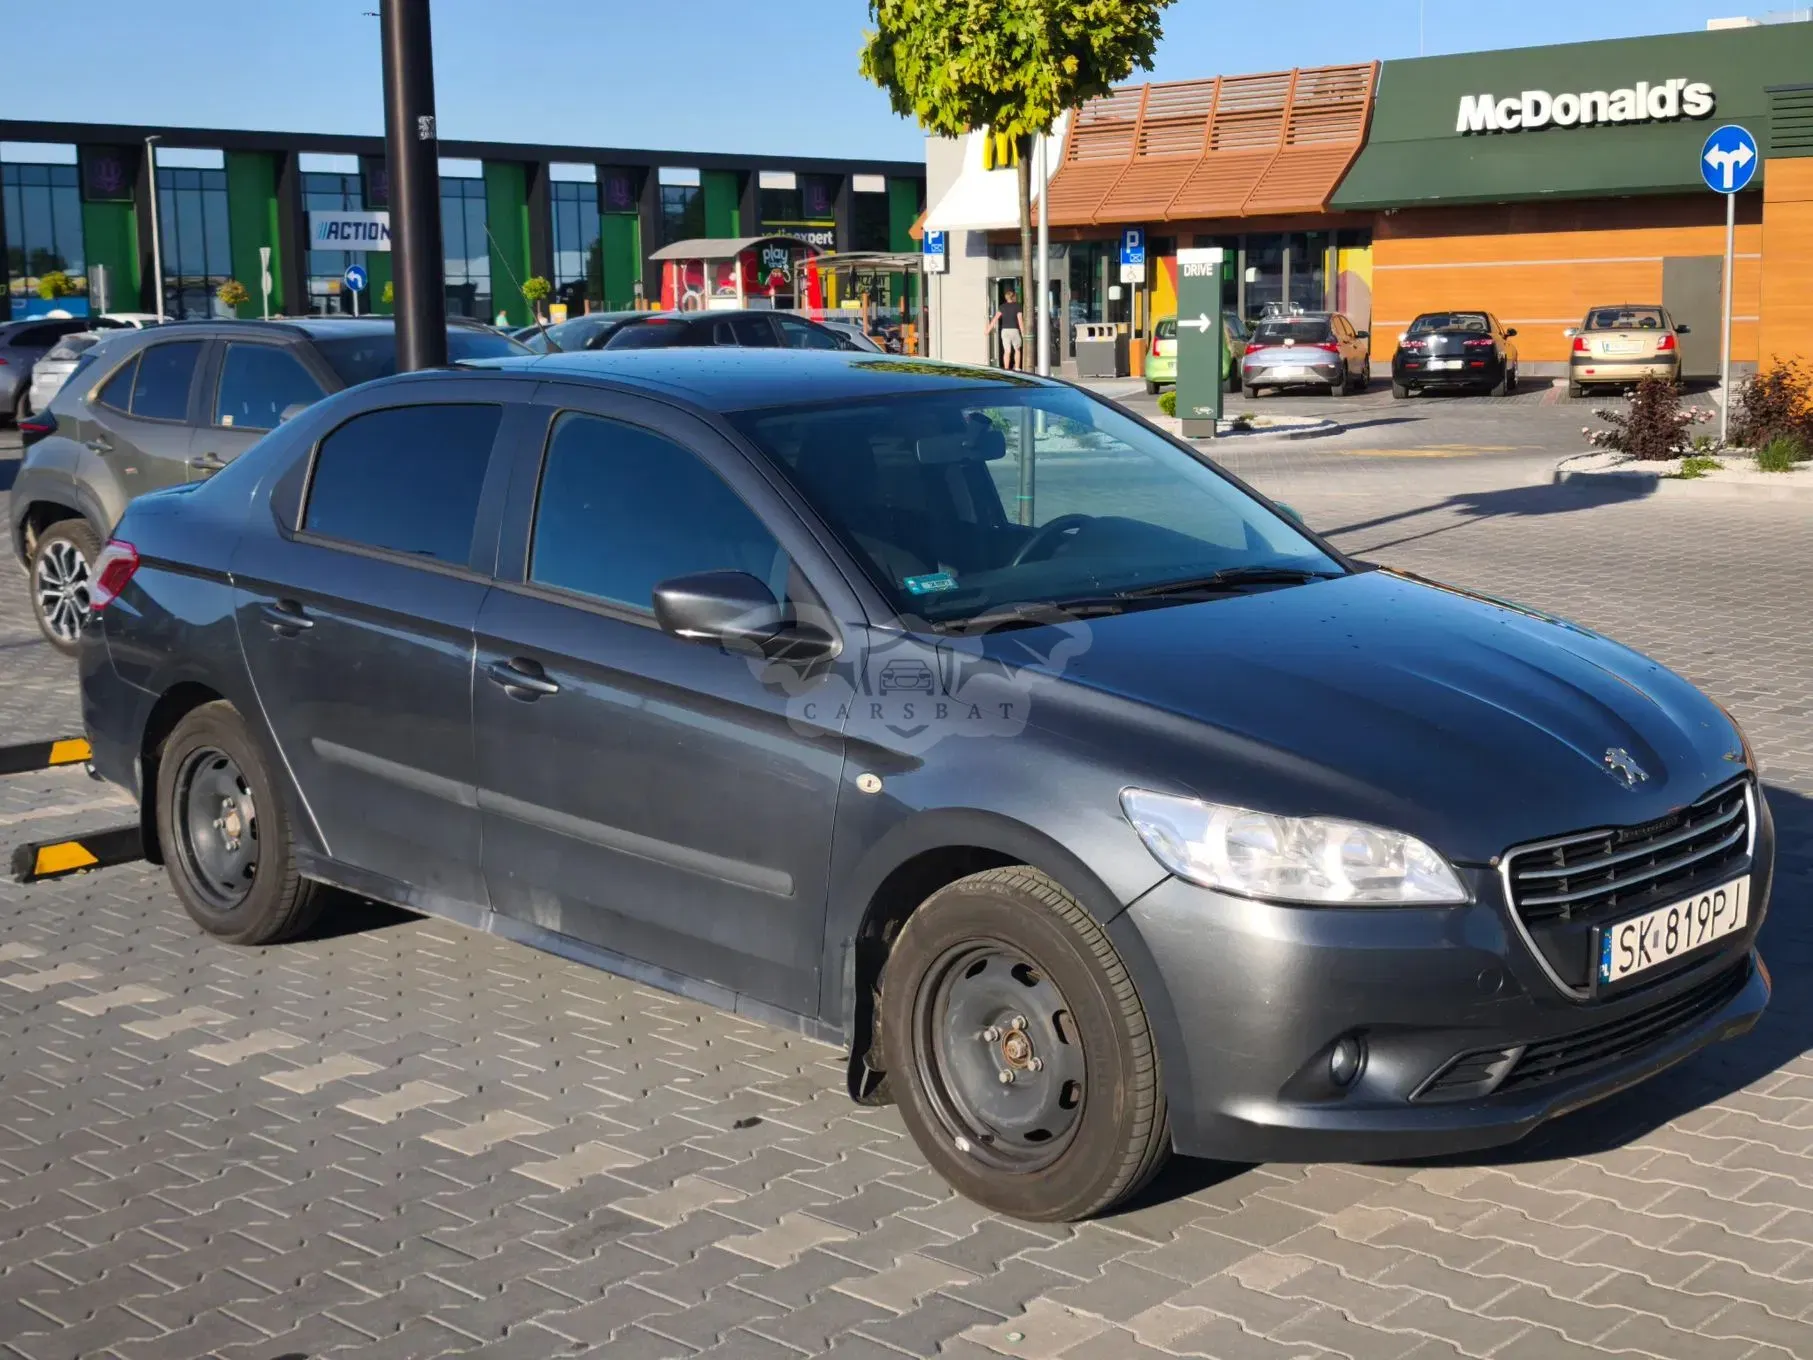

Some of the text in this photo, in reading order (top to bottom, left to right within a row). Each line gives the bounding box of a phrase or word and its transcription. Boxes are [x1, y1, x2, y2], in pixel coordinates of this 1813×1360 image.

[1456, 78, 1714, 131] McDonald's
[327, 222, 392, 240] ACTION
[1126, 230, 1139, 254] P
[762, 243, 789, 265] play
[1183, 263, 1213, 277] DRIVE
[1618, 882, 1741, 973] SK 819PJ
